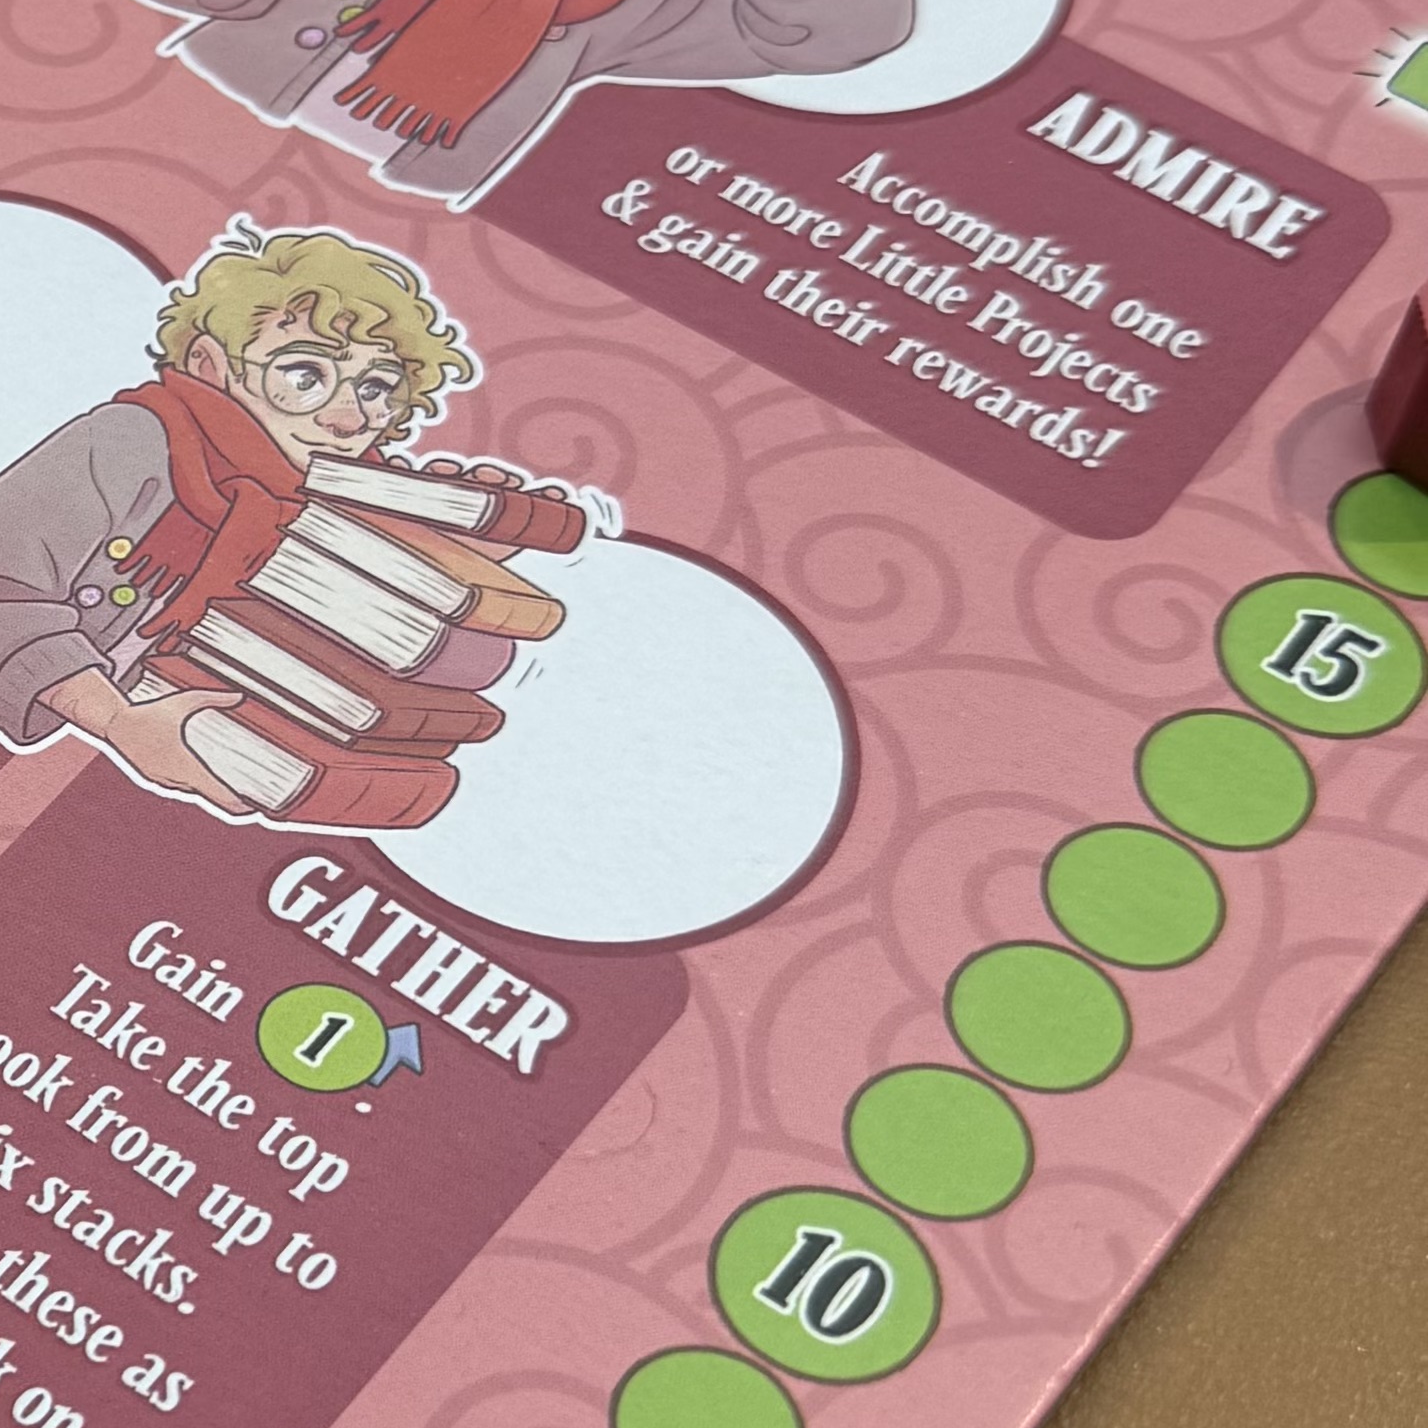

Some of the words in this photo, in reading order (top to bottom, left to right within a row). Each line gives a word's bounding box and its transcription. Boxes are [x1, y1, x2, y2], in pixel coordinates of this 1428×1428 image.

[837, 151, 1111, 312] Accomplish
[1110, 298, 1209, 360] one
[1026, 92, 1328, 259] ADMIRE
[599, 178, 653, 224] &
[637, 208, 755, 286] gain
[763, 266, 888, 349] their
[885, 337, 1128, 469] rewards!
[665, 144, 725, 185] or
[718, 173, 843, 248] more
[839, 225, 969, 317] Little
[969, 289, 1159, 416] Projects
[1265, 611, 1382, 699] 15
[125, 919, 248, 1022] Gain
[295, 1013, 353, 1066] 1
[265, 855, 571, 1076] GATHER
[49, 963, 168, 1071] Take
[165, 1052, 259, 1131] the
[258, 1116, 353, 1202] top
[26, 1172, 199, 1316] stacks.
[66, 1083, 201, 1198] from
[198, 1180, 276, 1255] up
[274, 1232, 340, 1292] to
[755, 1228, 892, 1341] 10
[121, 1351, 198, 1414] as
